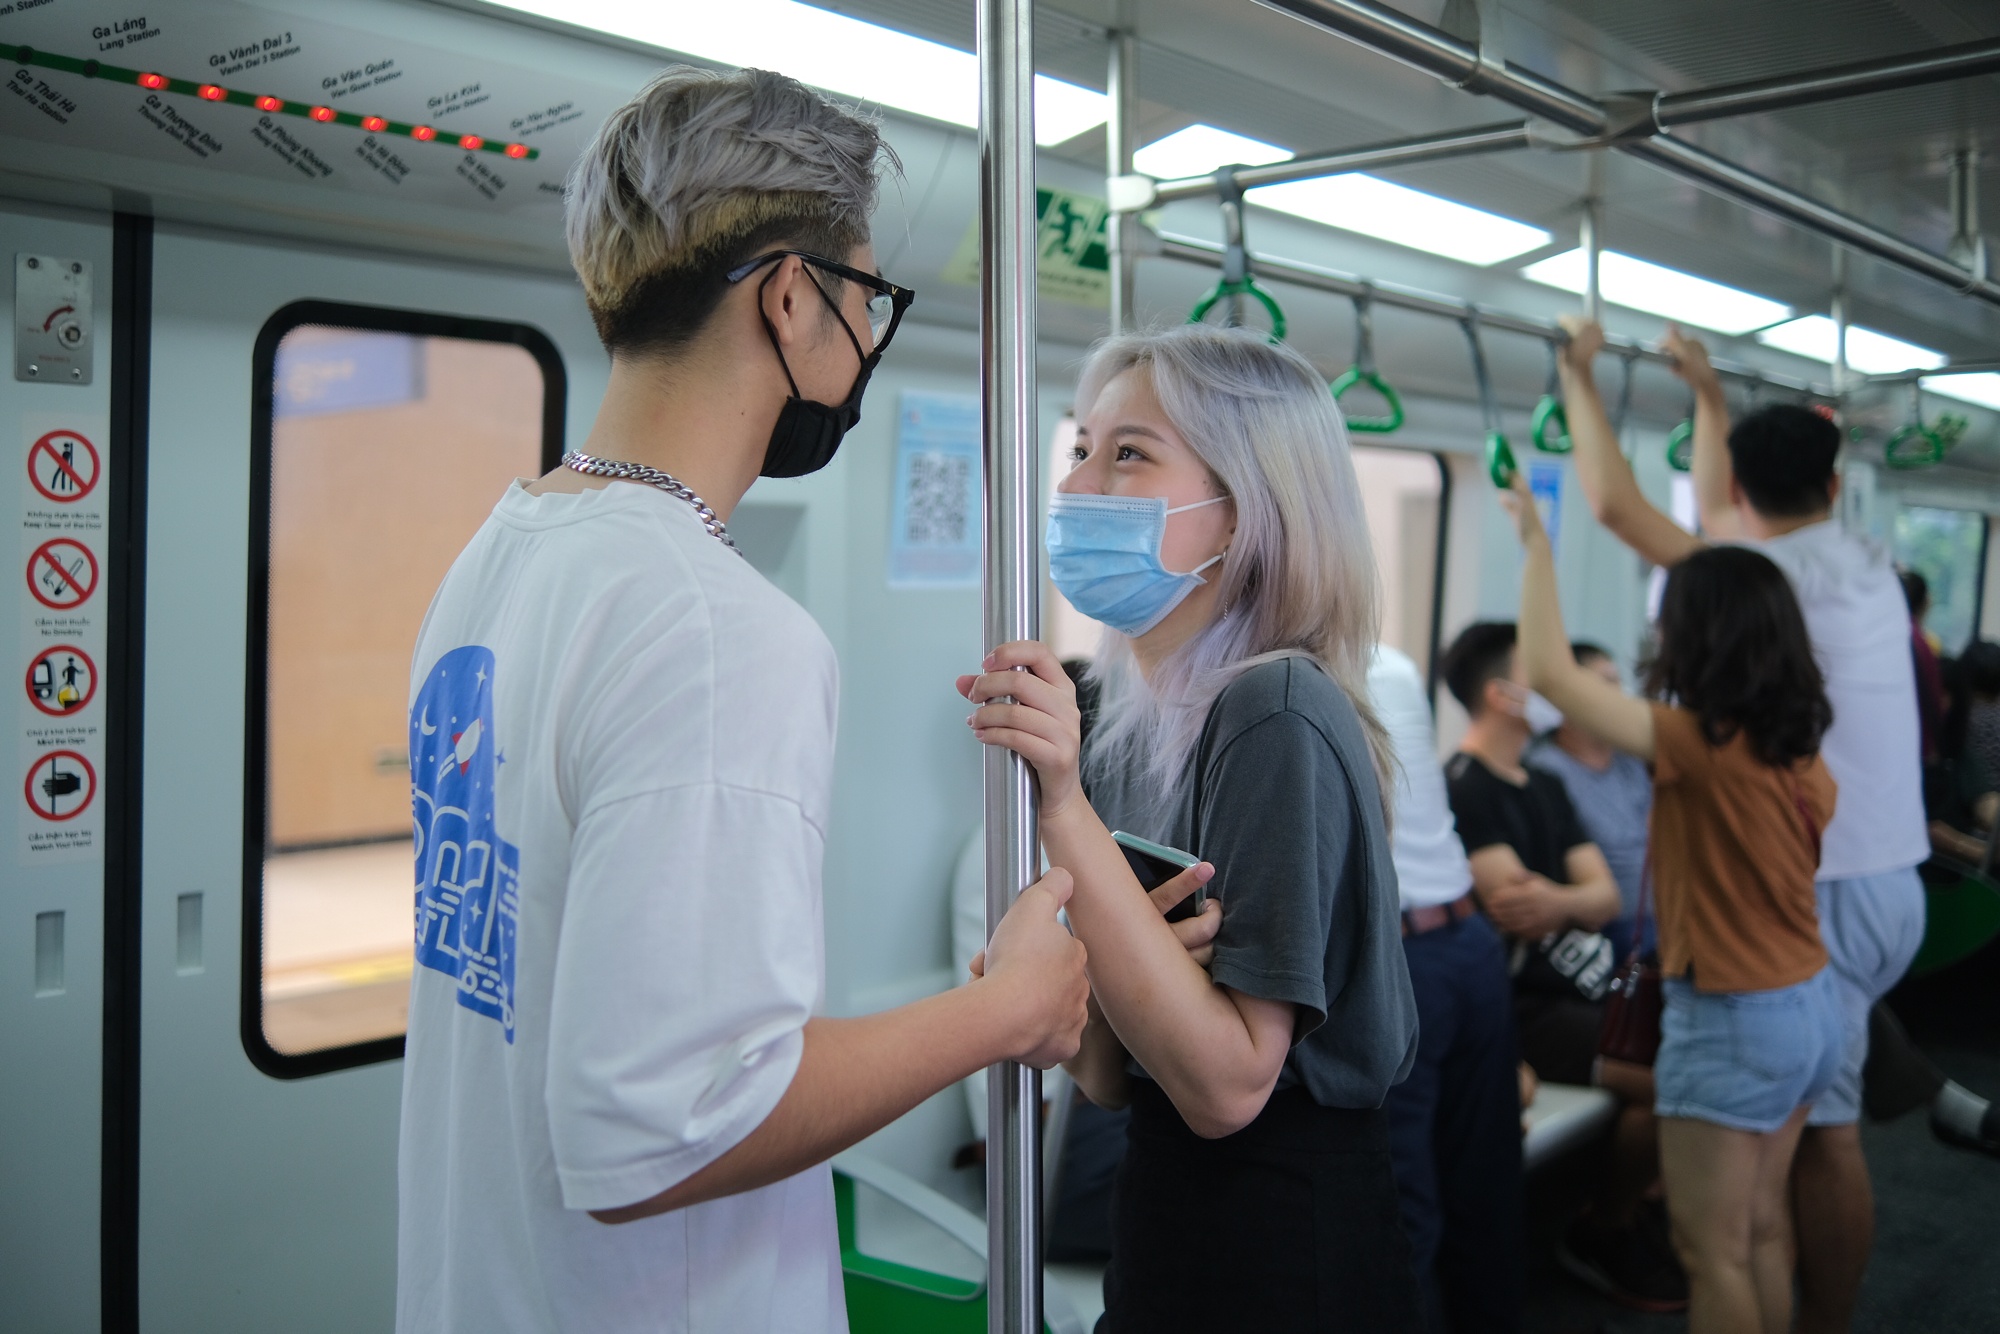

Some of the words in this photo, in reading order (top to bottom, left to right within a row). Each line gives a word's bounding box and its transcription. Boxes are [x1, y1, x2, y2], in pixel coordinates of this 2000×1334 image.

[92, 26, 111, 39] Ga
[114, 17, 147, 34] Láng
[99, 39, 124, 51] Lang
[126, 28, 161, 44] Station
[209, 54, 227, 67] Ga
[285, 32, 293, 44] 3
[220, 62, 244, 76] Vanh
[262, 54, 268, 64] 3
[269, 45, 301, 62] Station
[15, 69, 33, 85] Ga
[34, 80, 61, 103] Thái
[6, 79, 26, 97] Thai
[25, 92, 38, 106] Ha
[38, 102, 68, 125] Station
[145, 94, 162, 110] Ga
